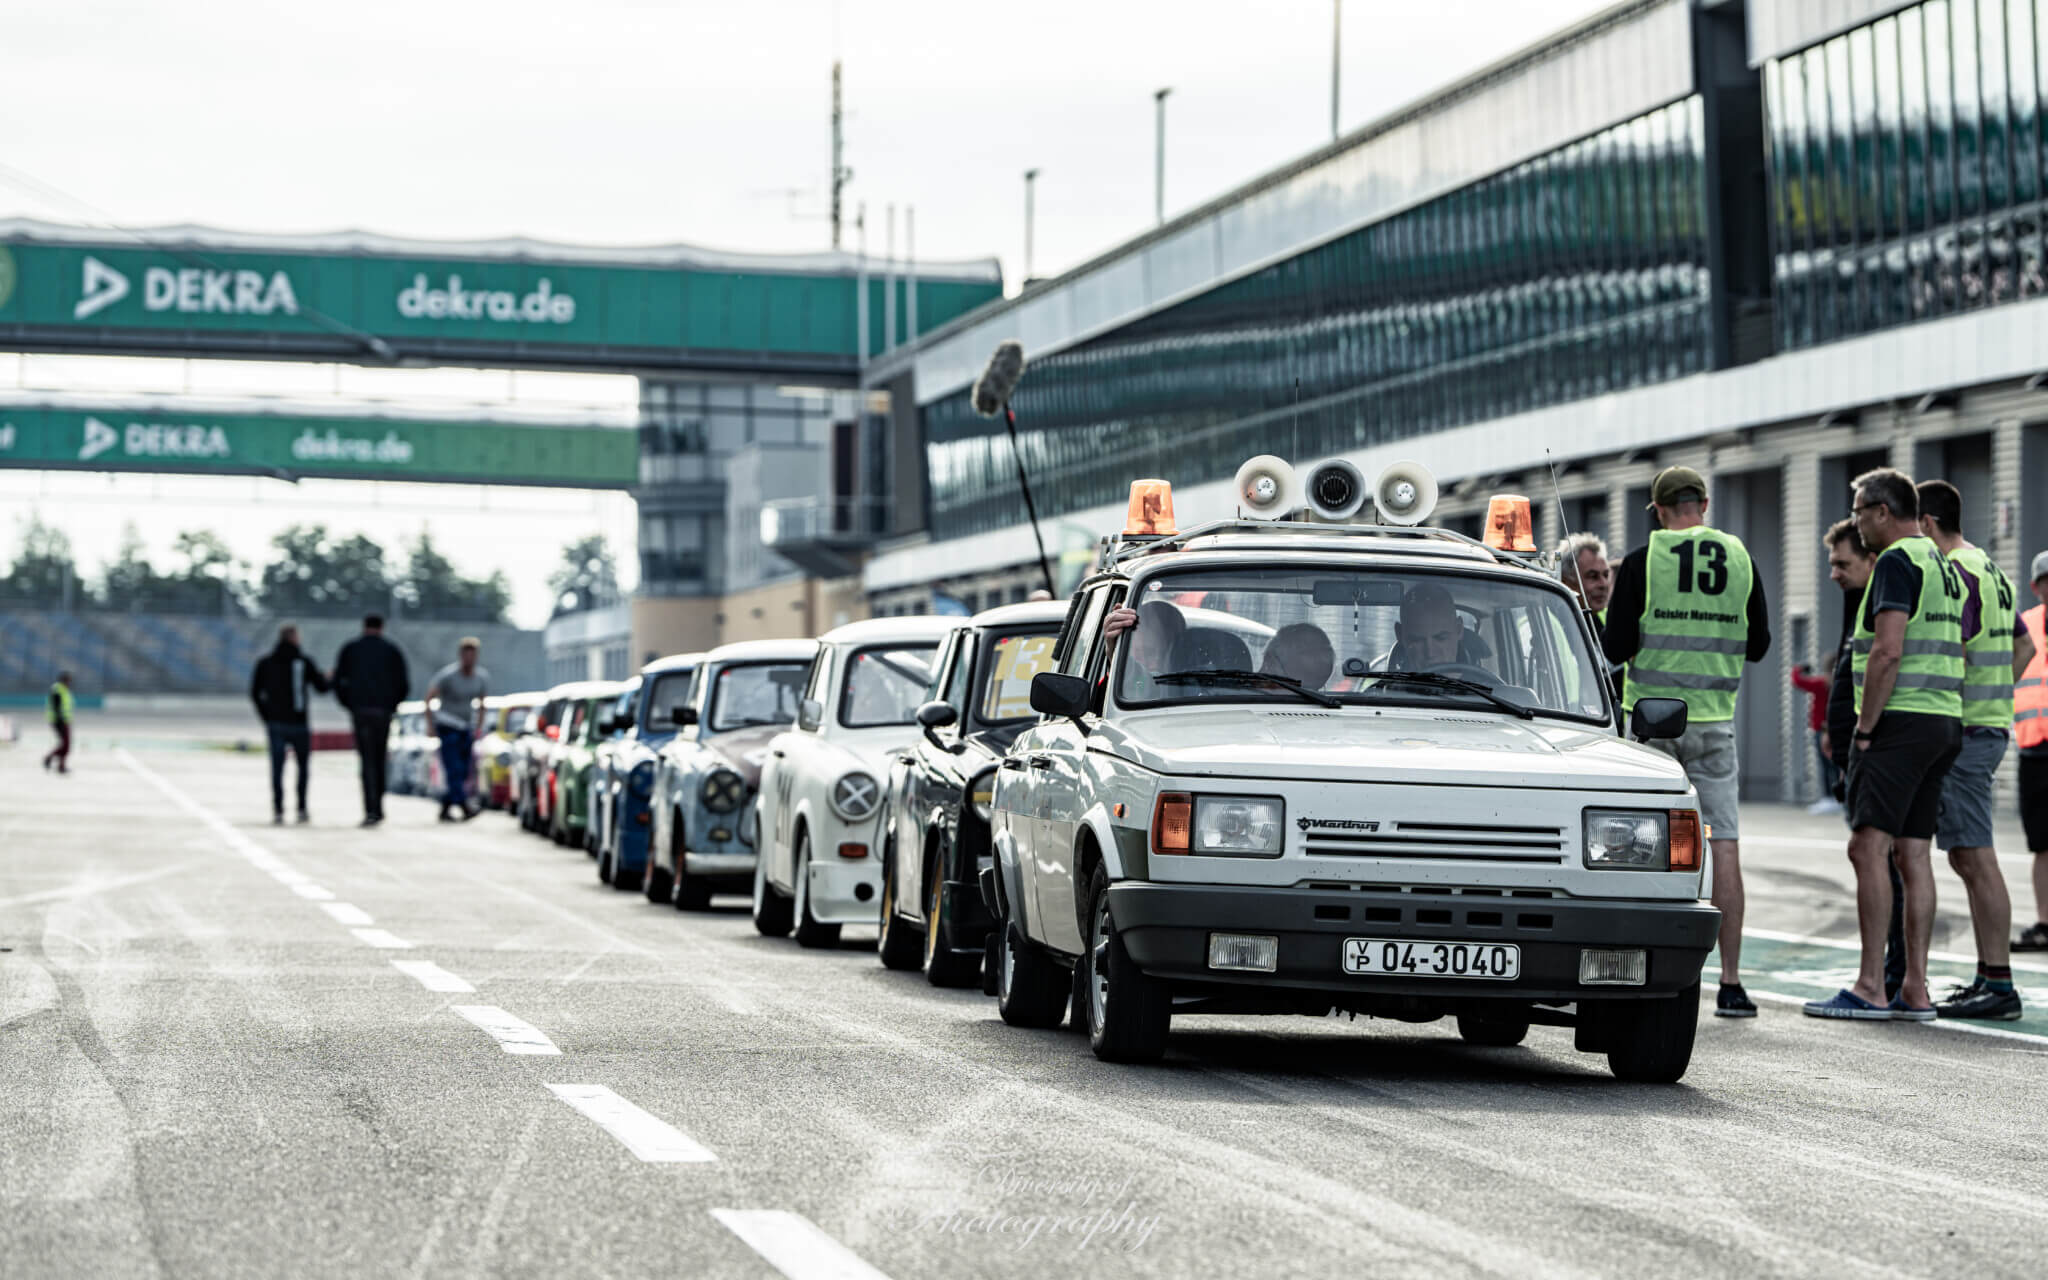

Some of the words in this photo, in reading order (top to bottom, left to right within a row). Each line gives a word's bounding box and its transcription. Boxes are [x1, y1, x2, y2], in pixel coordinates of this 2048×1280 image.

[143, 266, 299, 316] DEKRA
[397, 272, 577, 324] dekra.de
[124, 422, 231, 458] DEKRA
[292, 427, 414, 463] dekra.de
[1669, 539, 1728, 596] 13
[1928, 547, 1961, 600] 13
[1654, 608, 1689, 620] Geisler
[1690, 609, 1739, 624] Motorsport
[993, 636, 1057, 681] 13
[1311, 818, 1380, 832] Wartburg
[1382, 942, 1507, 976] 04-3040
